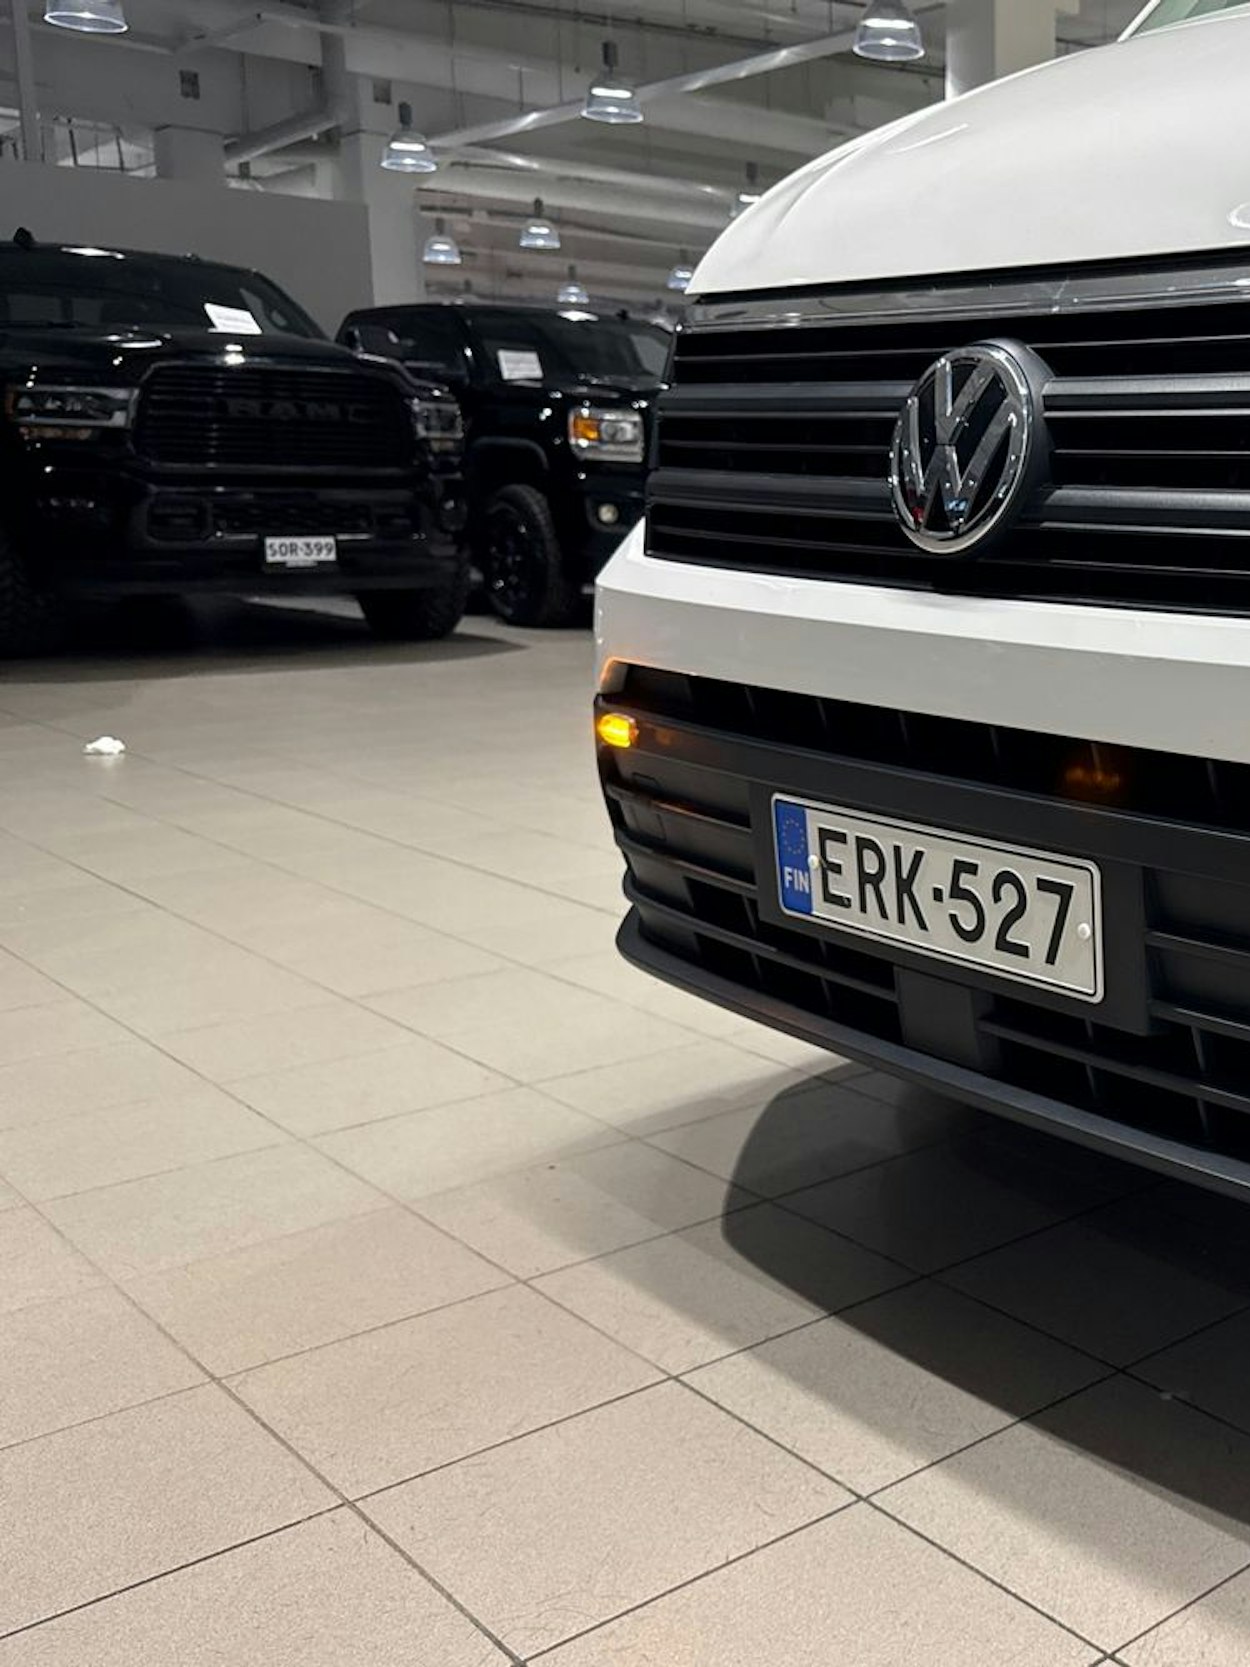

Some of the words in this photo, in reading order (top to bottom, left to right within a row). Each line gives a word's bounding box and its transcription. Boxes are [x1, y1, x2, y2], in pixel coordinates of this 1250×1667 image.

[227, 399, 340, 421] RAM
[892, 350, 1028, 546] VW
[268, 541, 334, 558] SOR-399
[784, 866, 809, 894] FIN
[817, 826, 1075, 966] ERK-527
